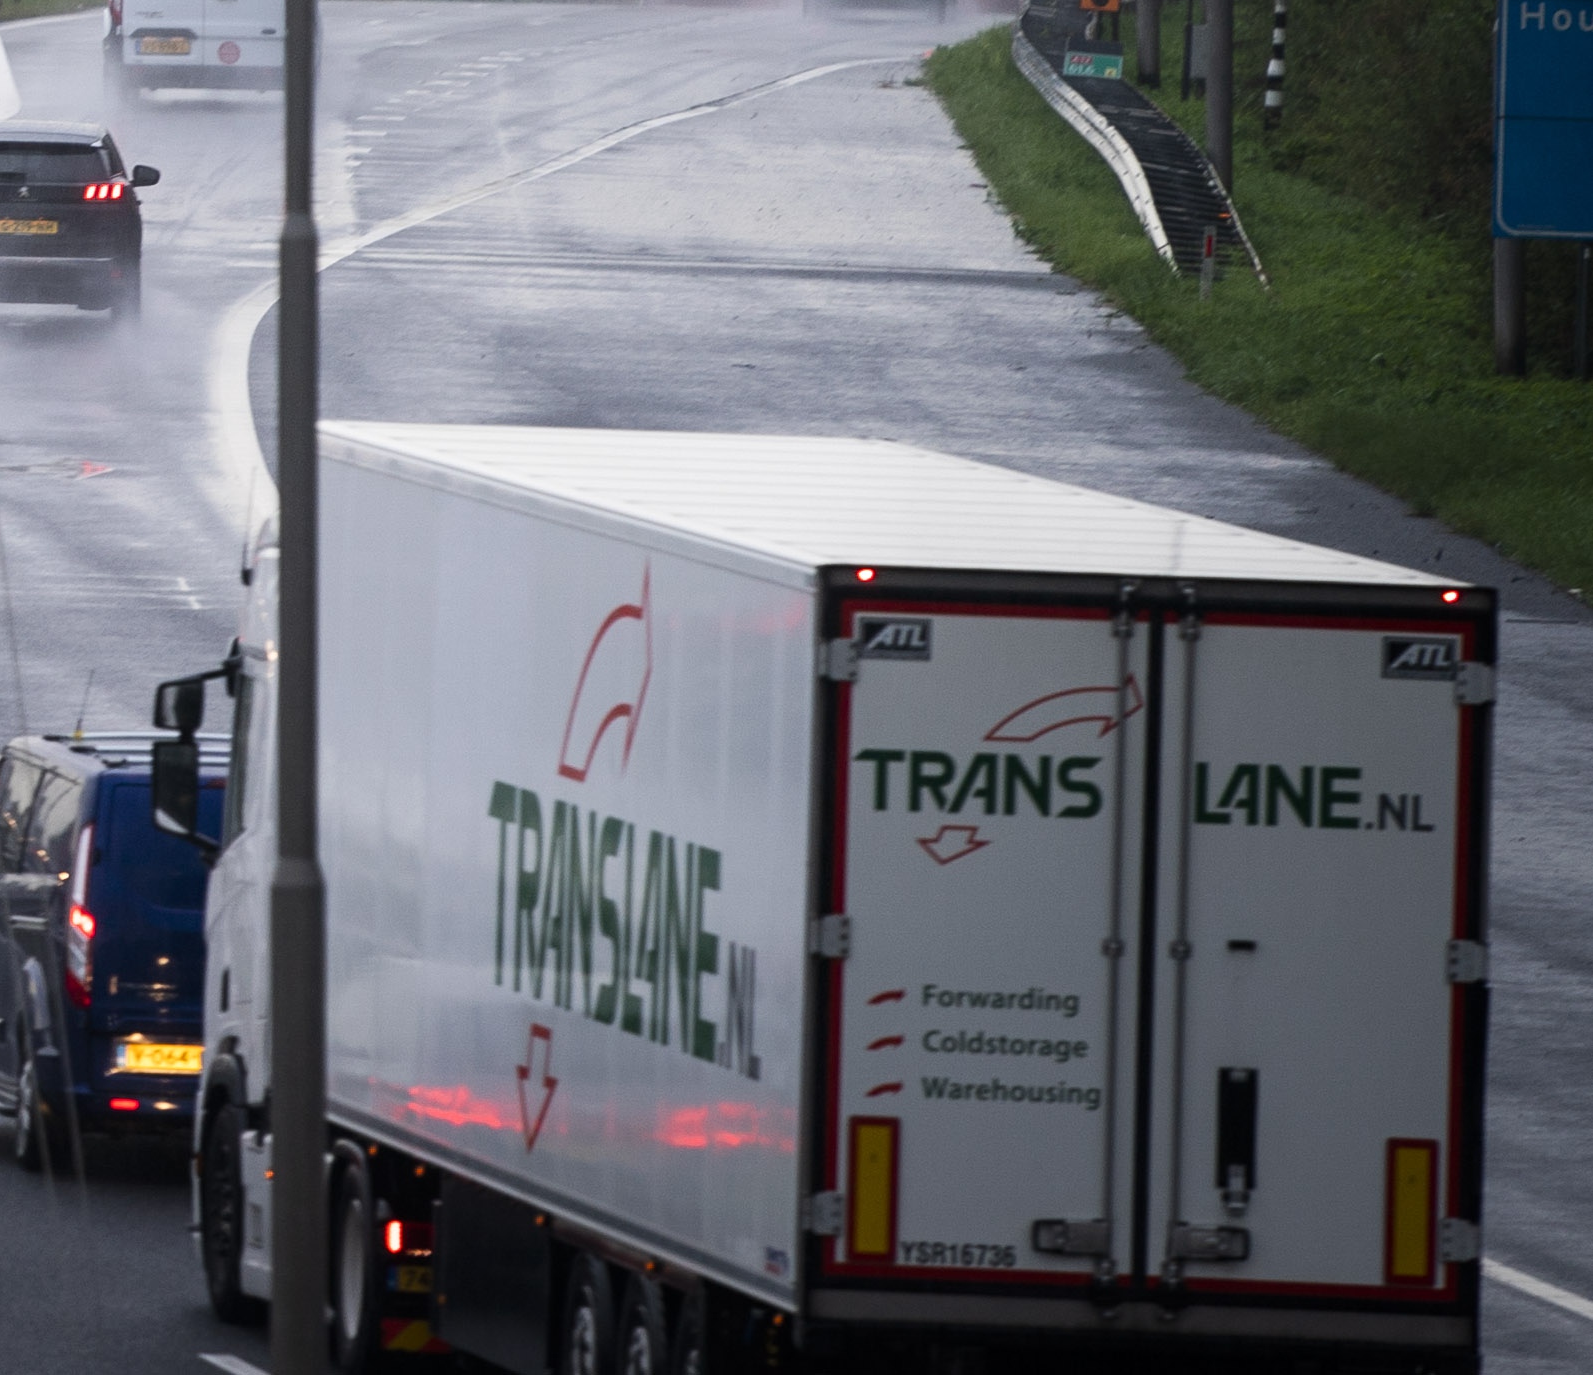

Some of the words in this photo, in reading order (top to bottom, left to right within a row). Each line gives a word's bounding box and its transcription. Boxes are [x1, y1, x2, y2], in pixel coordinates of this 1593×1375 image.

[1520, 2, 1593, 32] Hou
[867, 623, 928, 650] ATL
[1390, 644, 1453, 669] ATL
[853, 748, 1104, 819] TRANS
[1195, 761, 1436, 832] LANE.NL
[488, 780, 760, 1082] TRANSLANE.NL
[921, 984, 1080, 1018] Forwarding
[921, 1029, 1089, 1063] Coldstorage
[920, 1076, 1102, 1111] Warehousing
